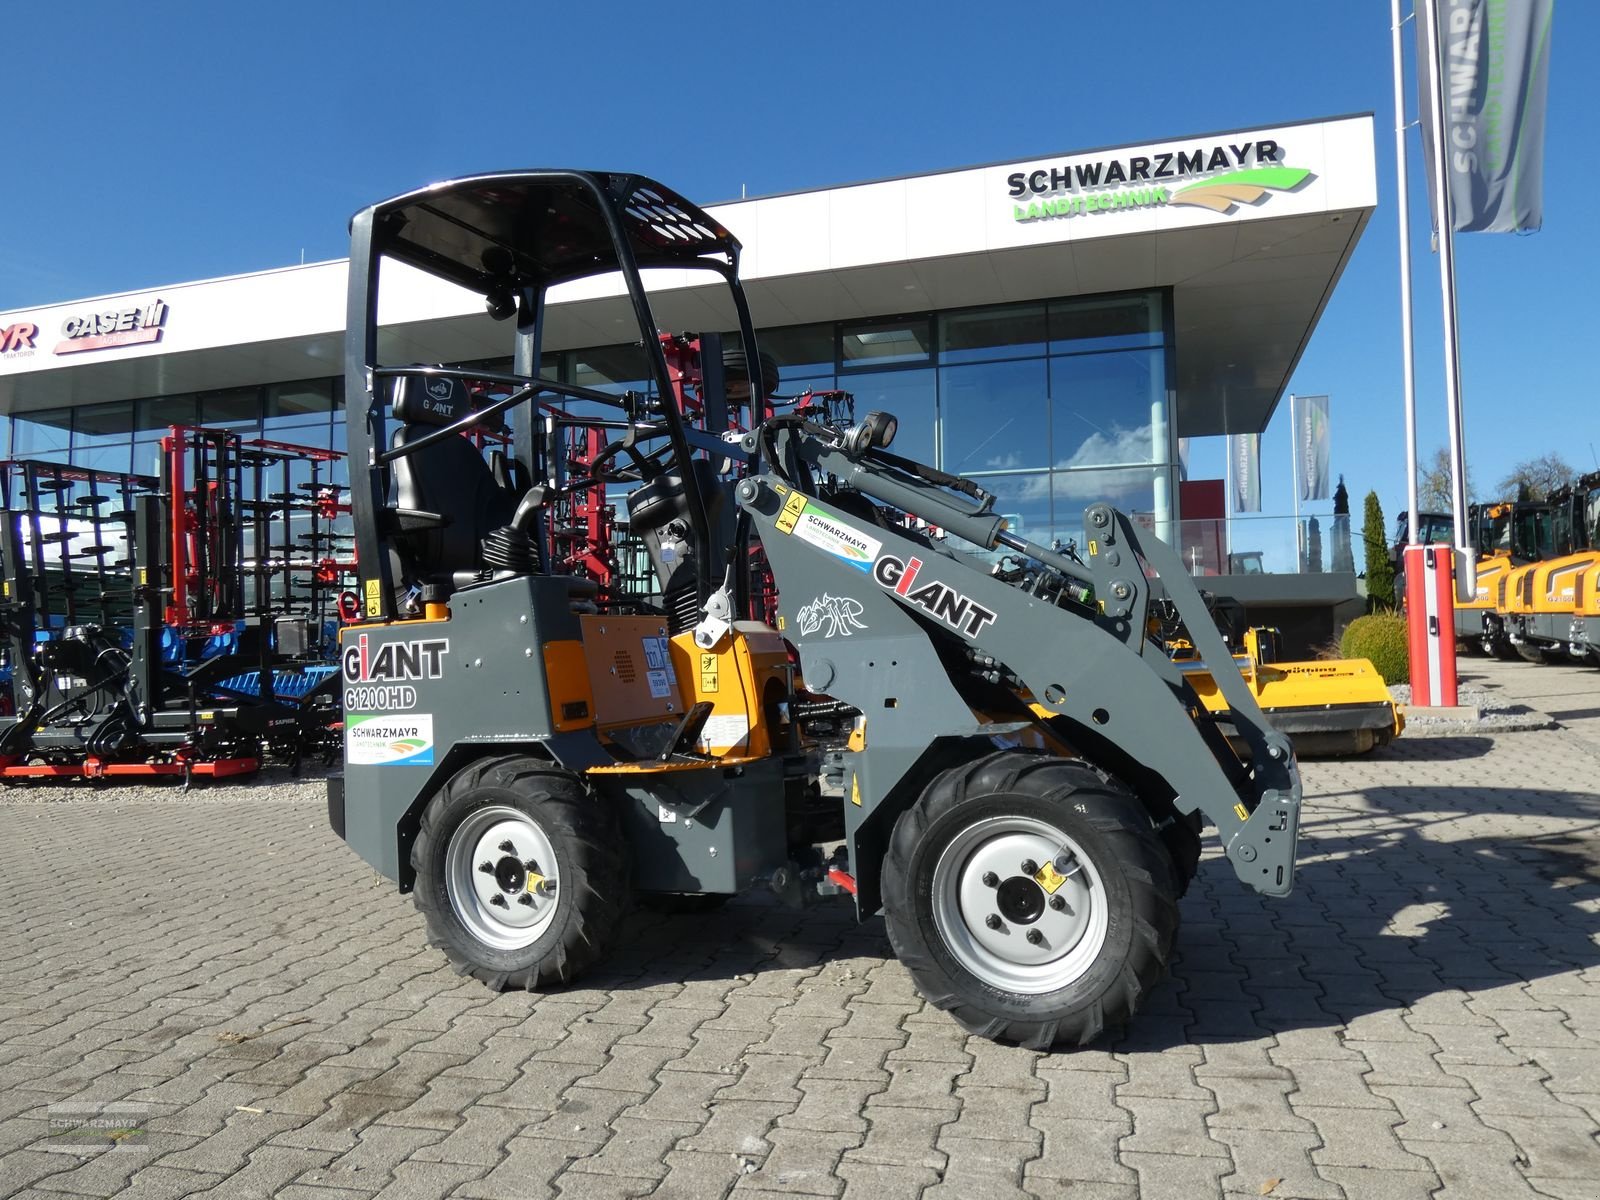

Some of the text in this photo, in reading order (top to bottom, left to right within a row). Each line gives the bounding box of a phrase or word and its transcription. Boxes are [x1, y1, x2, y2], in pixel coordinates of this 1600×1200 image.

[1450, 0, 1480, 174] SCHWAR
[1007, 140, 1278, 196] SCHWARZMAYR
[1013, 186, 1168, 221] LANDTECHNIK
[61, 308, 139, 339] CASE
[808, 515, 868, 551] SCHWARZMAYR
[345, 685, 417, 711] G1200HD
[352, 727, 418, 738] SCHWARZMAYR
